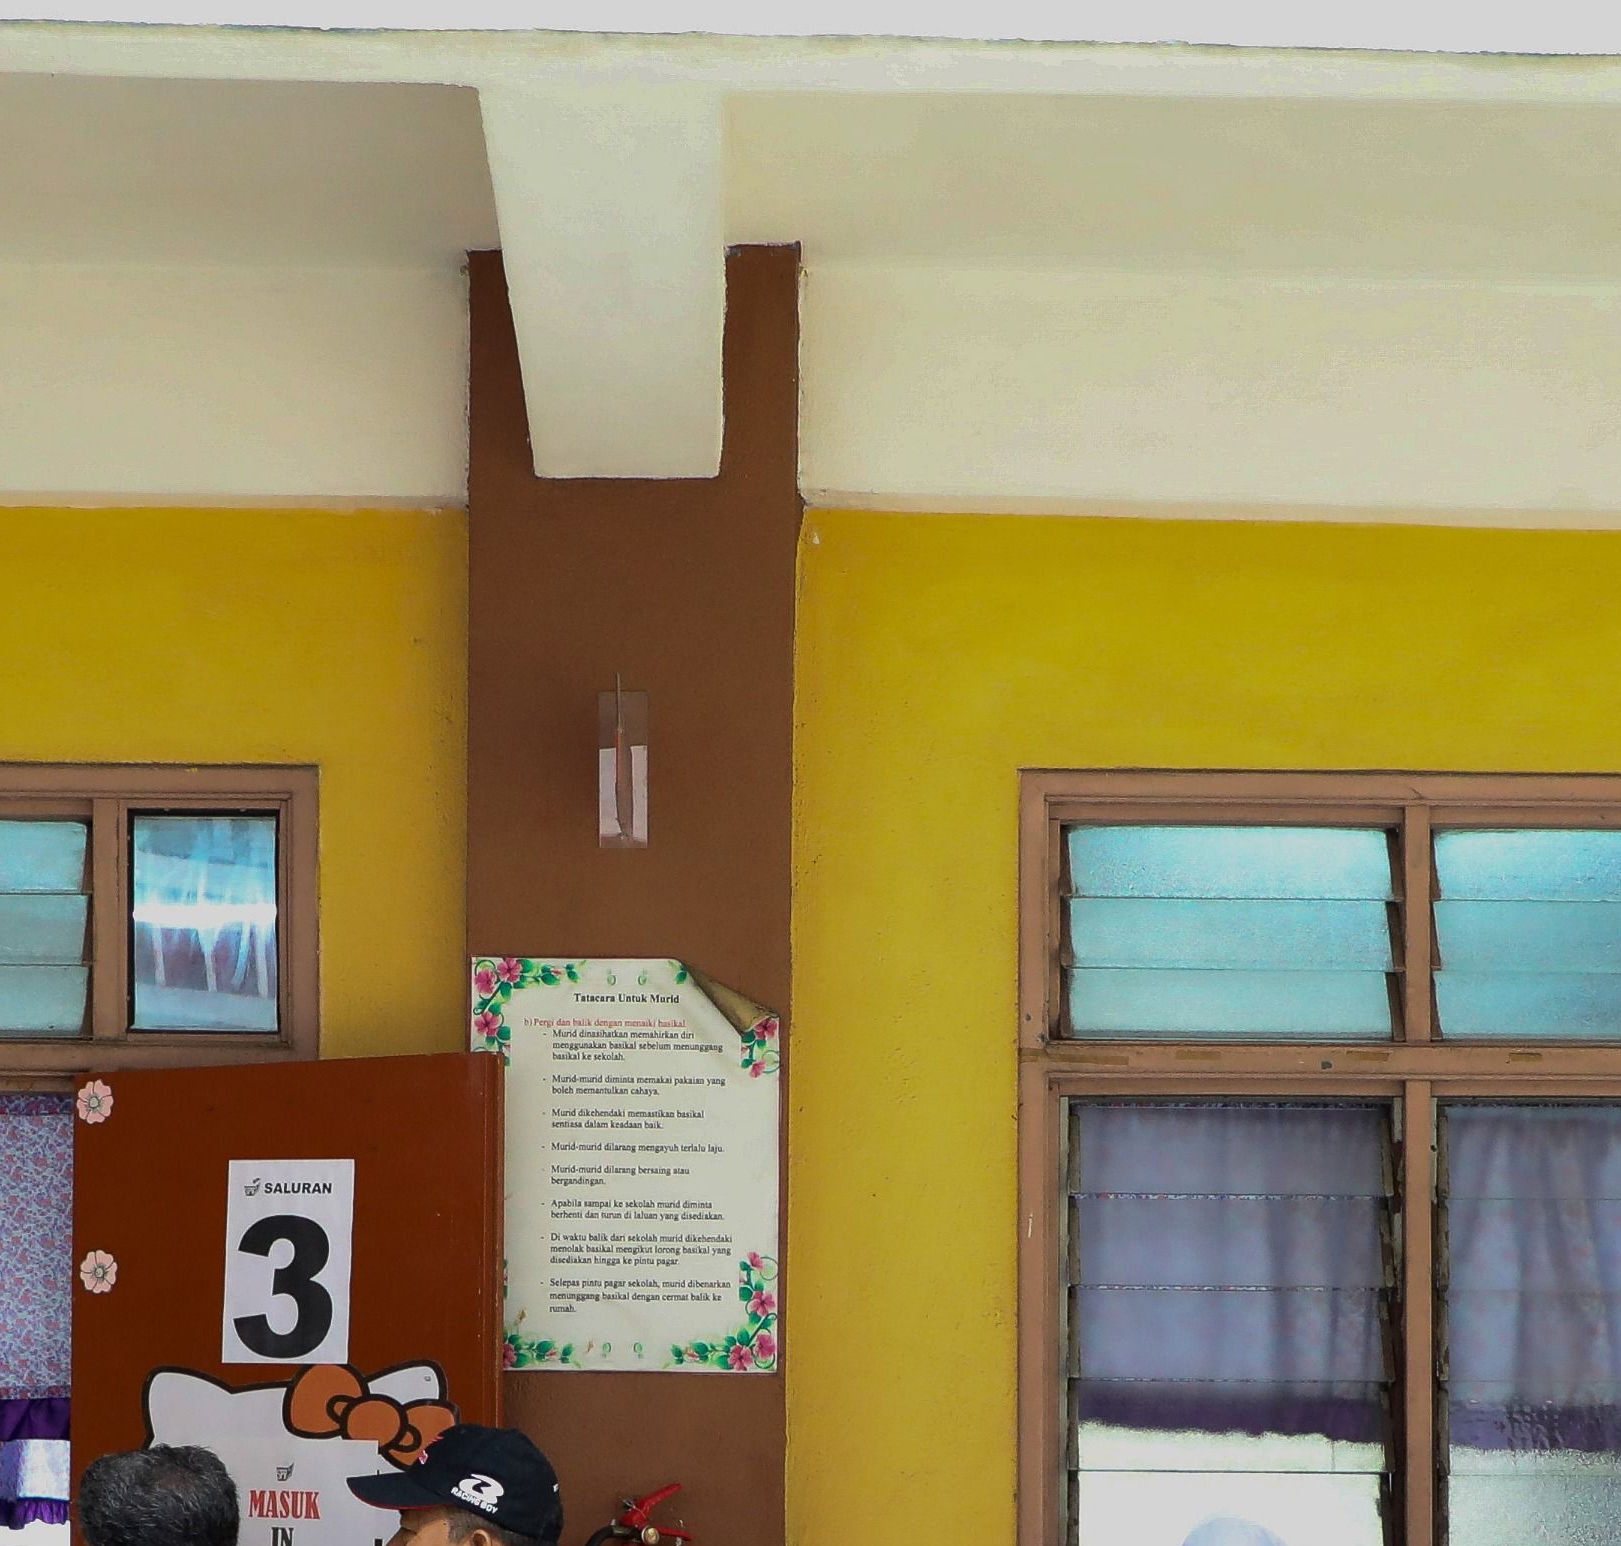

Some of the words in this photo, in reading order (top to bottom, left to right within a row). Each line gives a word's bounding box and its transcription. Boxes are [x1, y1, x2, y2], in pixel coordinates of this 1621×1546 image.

[573, 994, 615, 1003] Tatacara
[617, 994, 647, 1003] Untuk
[649, 995, 679, 1003] Murid
[552, 1029, 577, 1038] Murid
[578, 1030, 628, 1038] dinasihatkan
[629, 1030, 679, 1039] memahirkan
[680, 1030, 694, 1039] diri
[551, 1142, 602, 1151] Murid-murid
[603, 1143, 636, 1153] dilarang
[637, 1143, 679, 1153] mengayuh
[680, 1143, 706, 1152] terlalu
[707, 1144, 725, 1154] laju.
[264, 1182, 332, 1194] SALURAN
[551, 1199, 582, 1209] Apabila
[583, 1199, 611, 1209] sampai
[612, 1199, 623, 1208] ke
[624, 1199, 655, 1208] sekolah
[656, 1200, 680, 1208] murid
[681, 1200, 712, 1208] diminta
[233, 1214, 333, 1359] 3
[451, 1486, 480, 1506] RACING
[249, 1490, 320, 1520] MASUK
